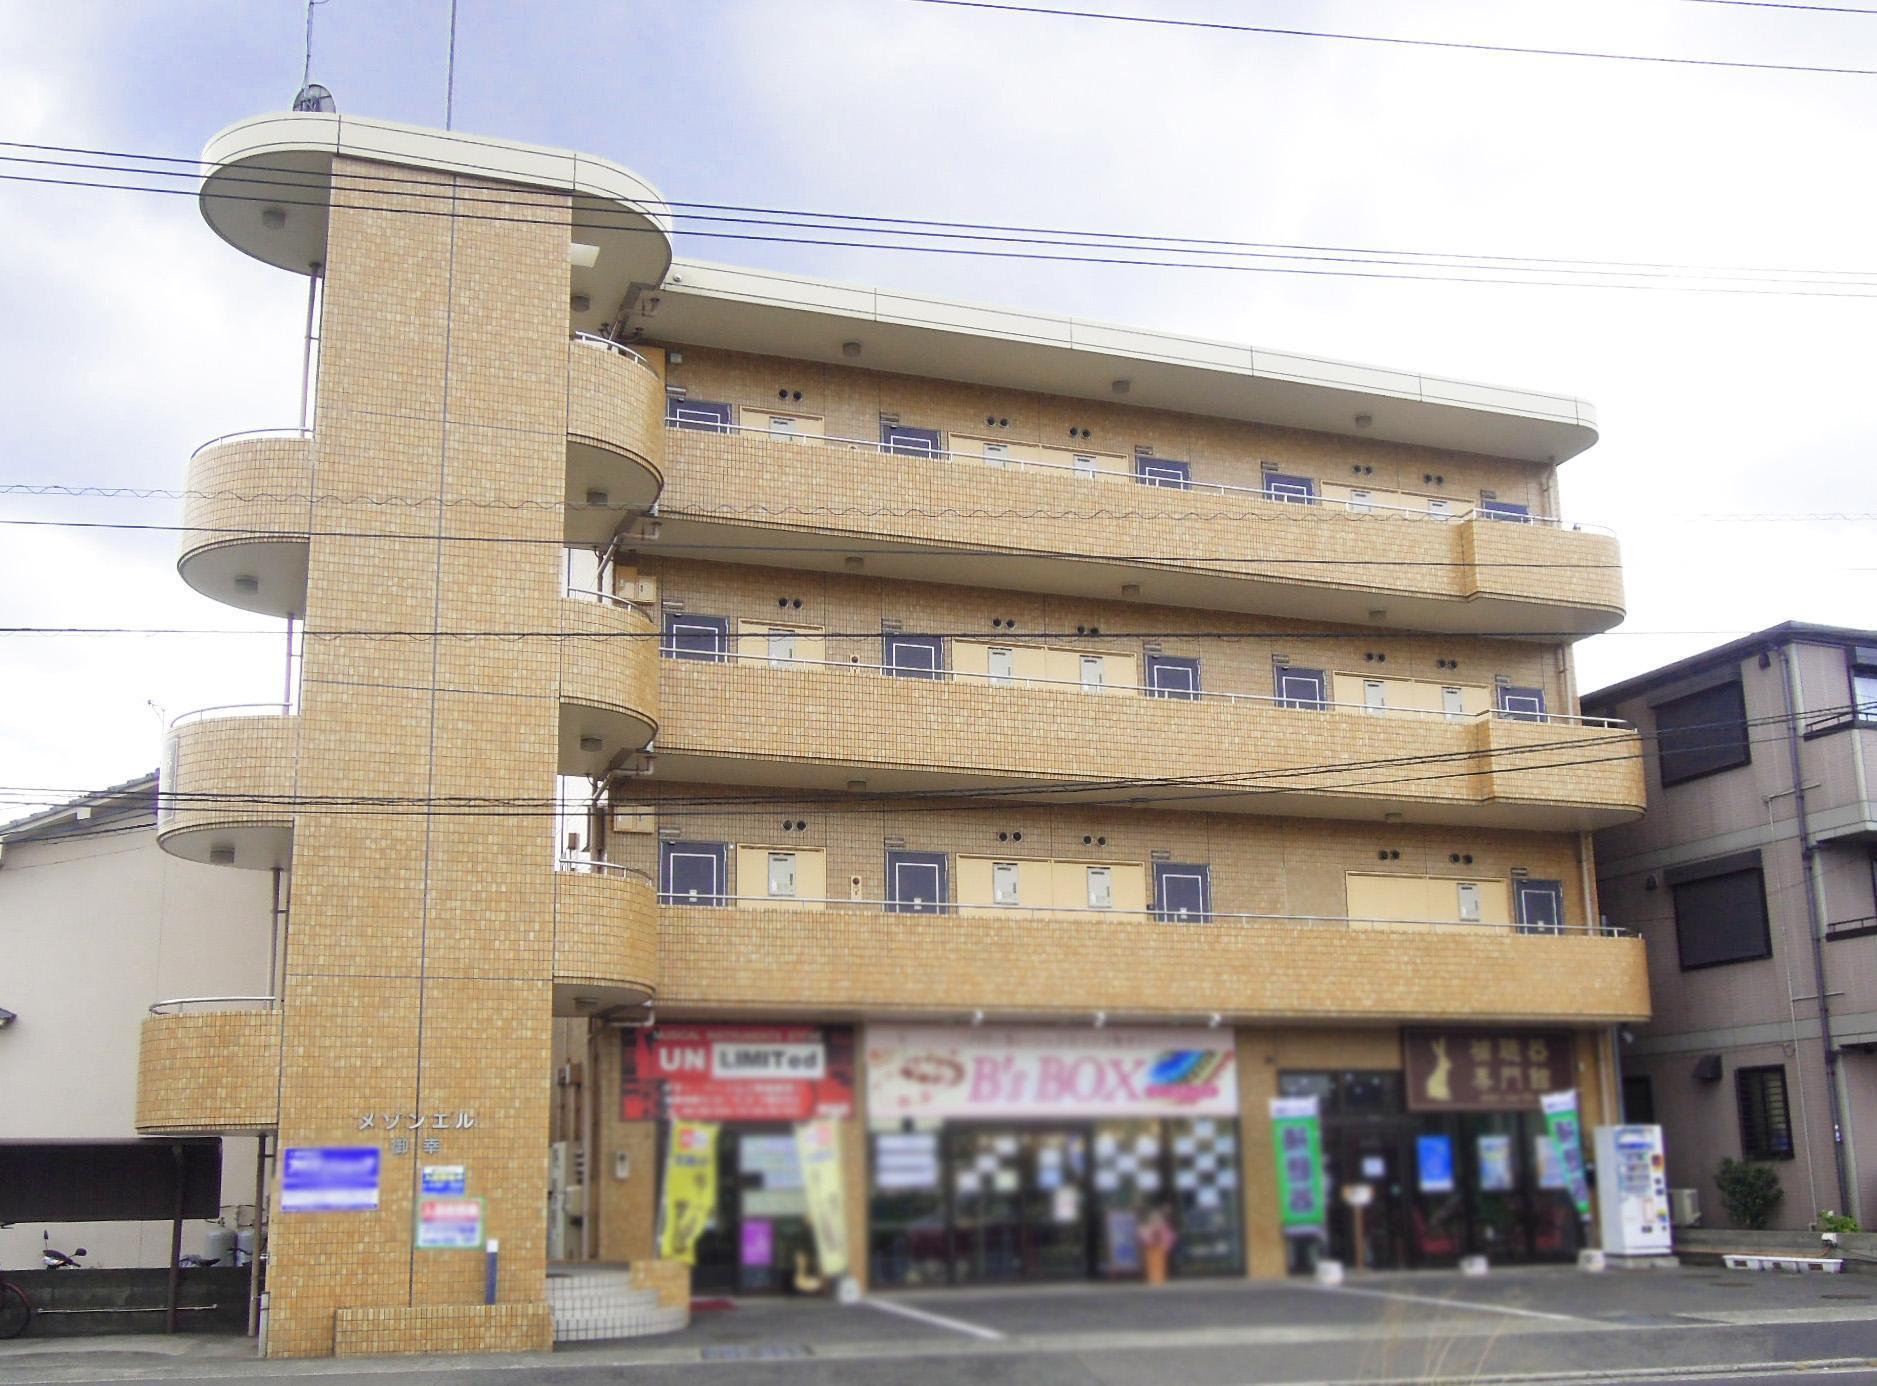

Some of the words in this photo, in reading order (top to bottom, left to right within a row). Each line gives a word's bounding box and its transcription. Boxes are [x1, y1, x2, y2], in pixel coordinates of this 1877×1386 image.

[659, 1047, 705, 1071] UN
[719, 1050, 818, 1070] LIMITed
[1032, 1054, 1146, 1102] BOX
